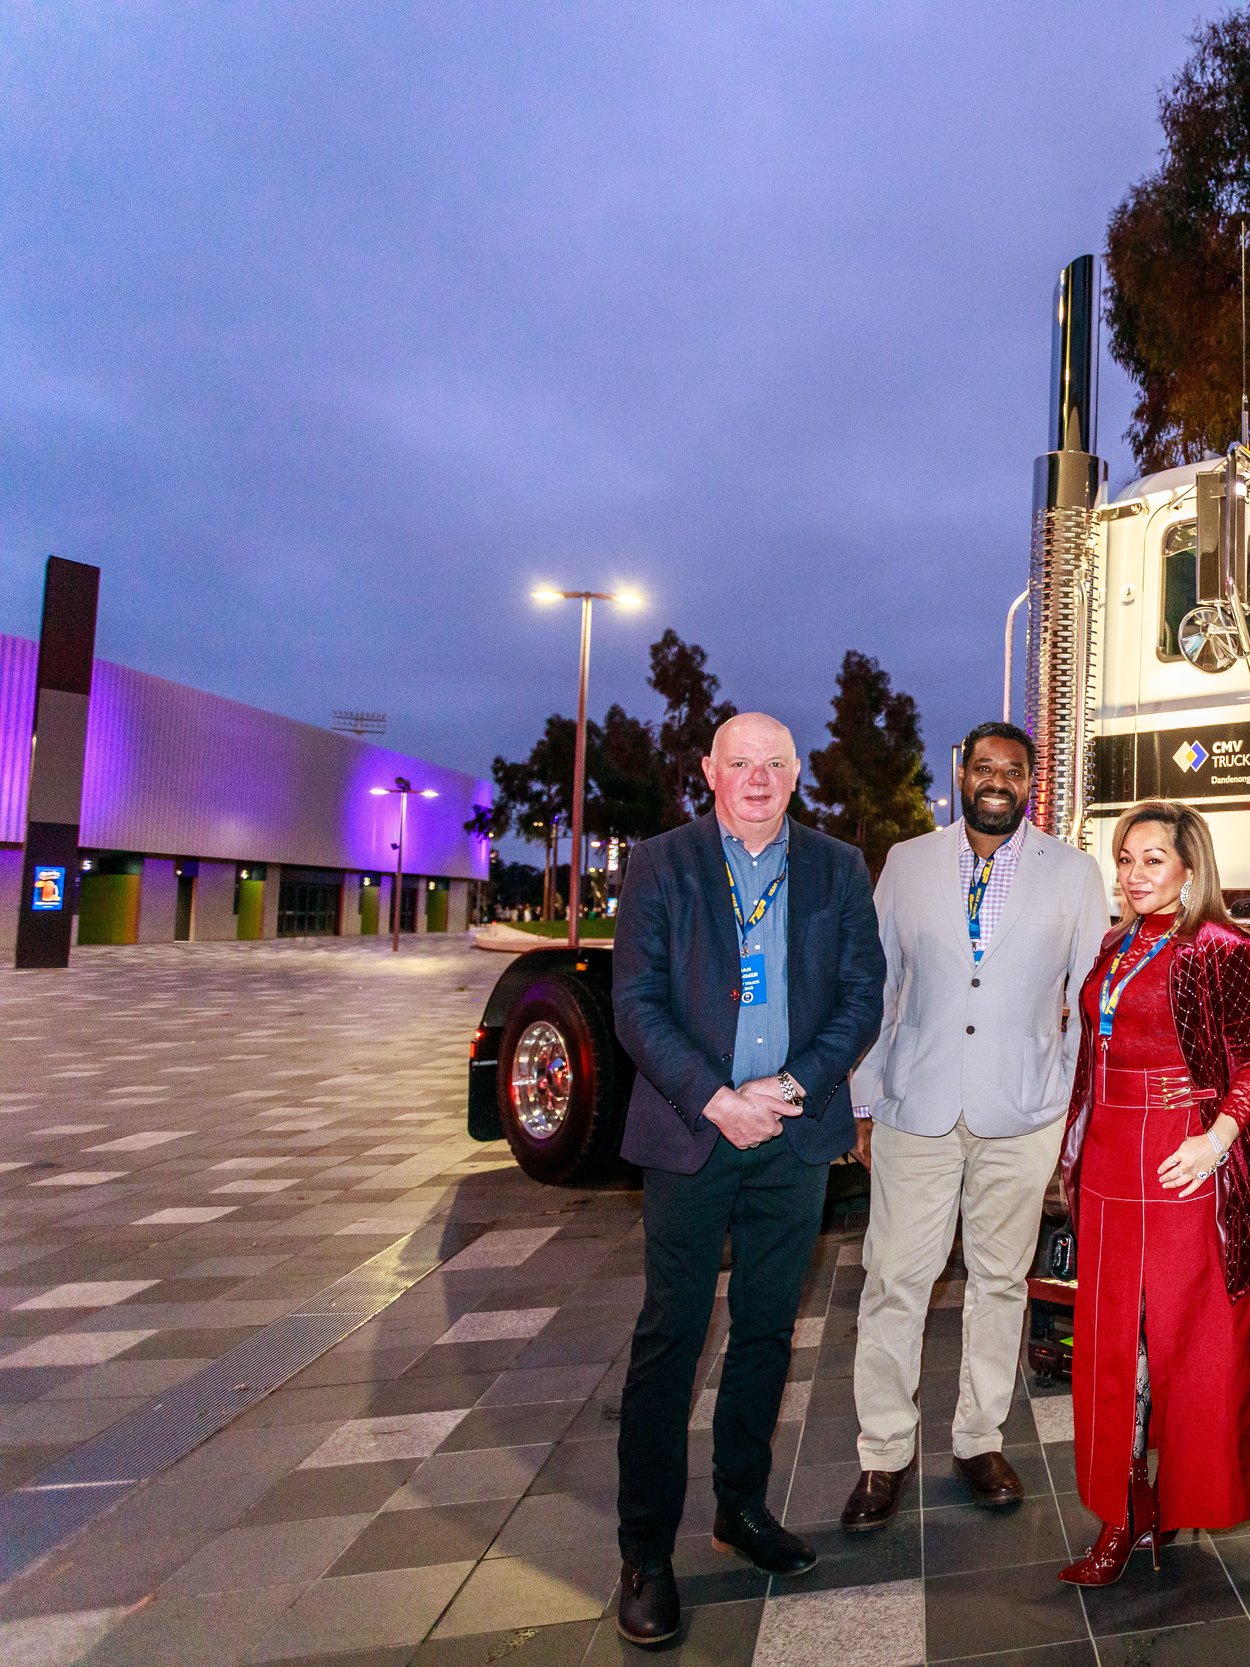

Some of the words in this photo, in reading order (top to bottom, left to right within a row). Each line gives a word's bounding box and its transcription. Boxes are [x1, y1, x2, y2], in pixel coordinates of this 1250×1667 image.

[1211, 740, 1243, 754] CMV
[1212, 754, 1250, 768] TRUCK
[82, 860, 92, 871] 5
